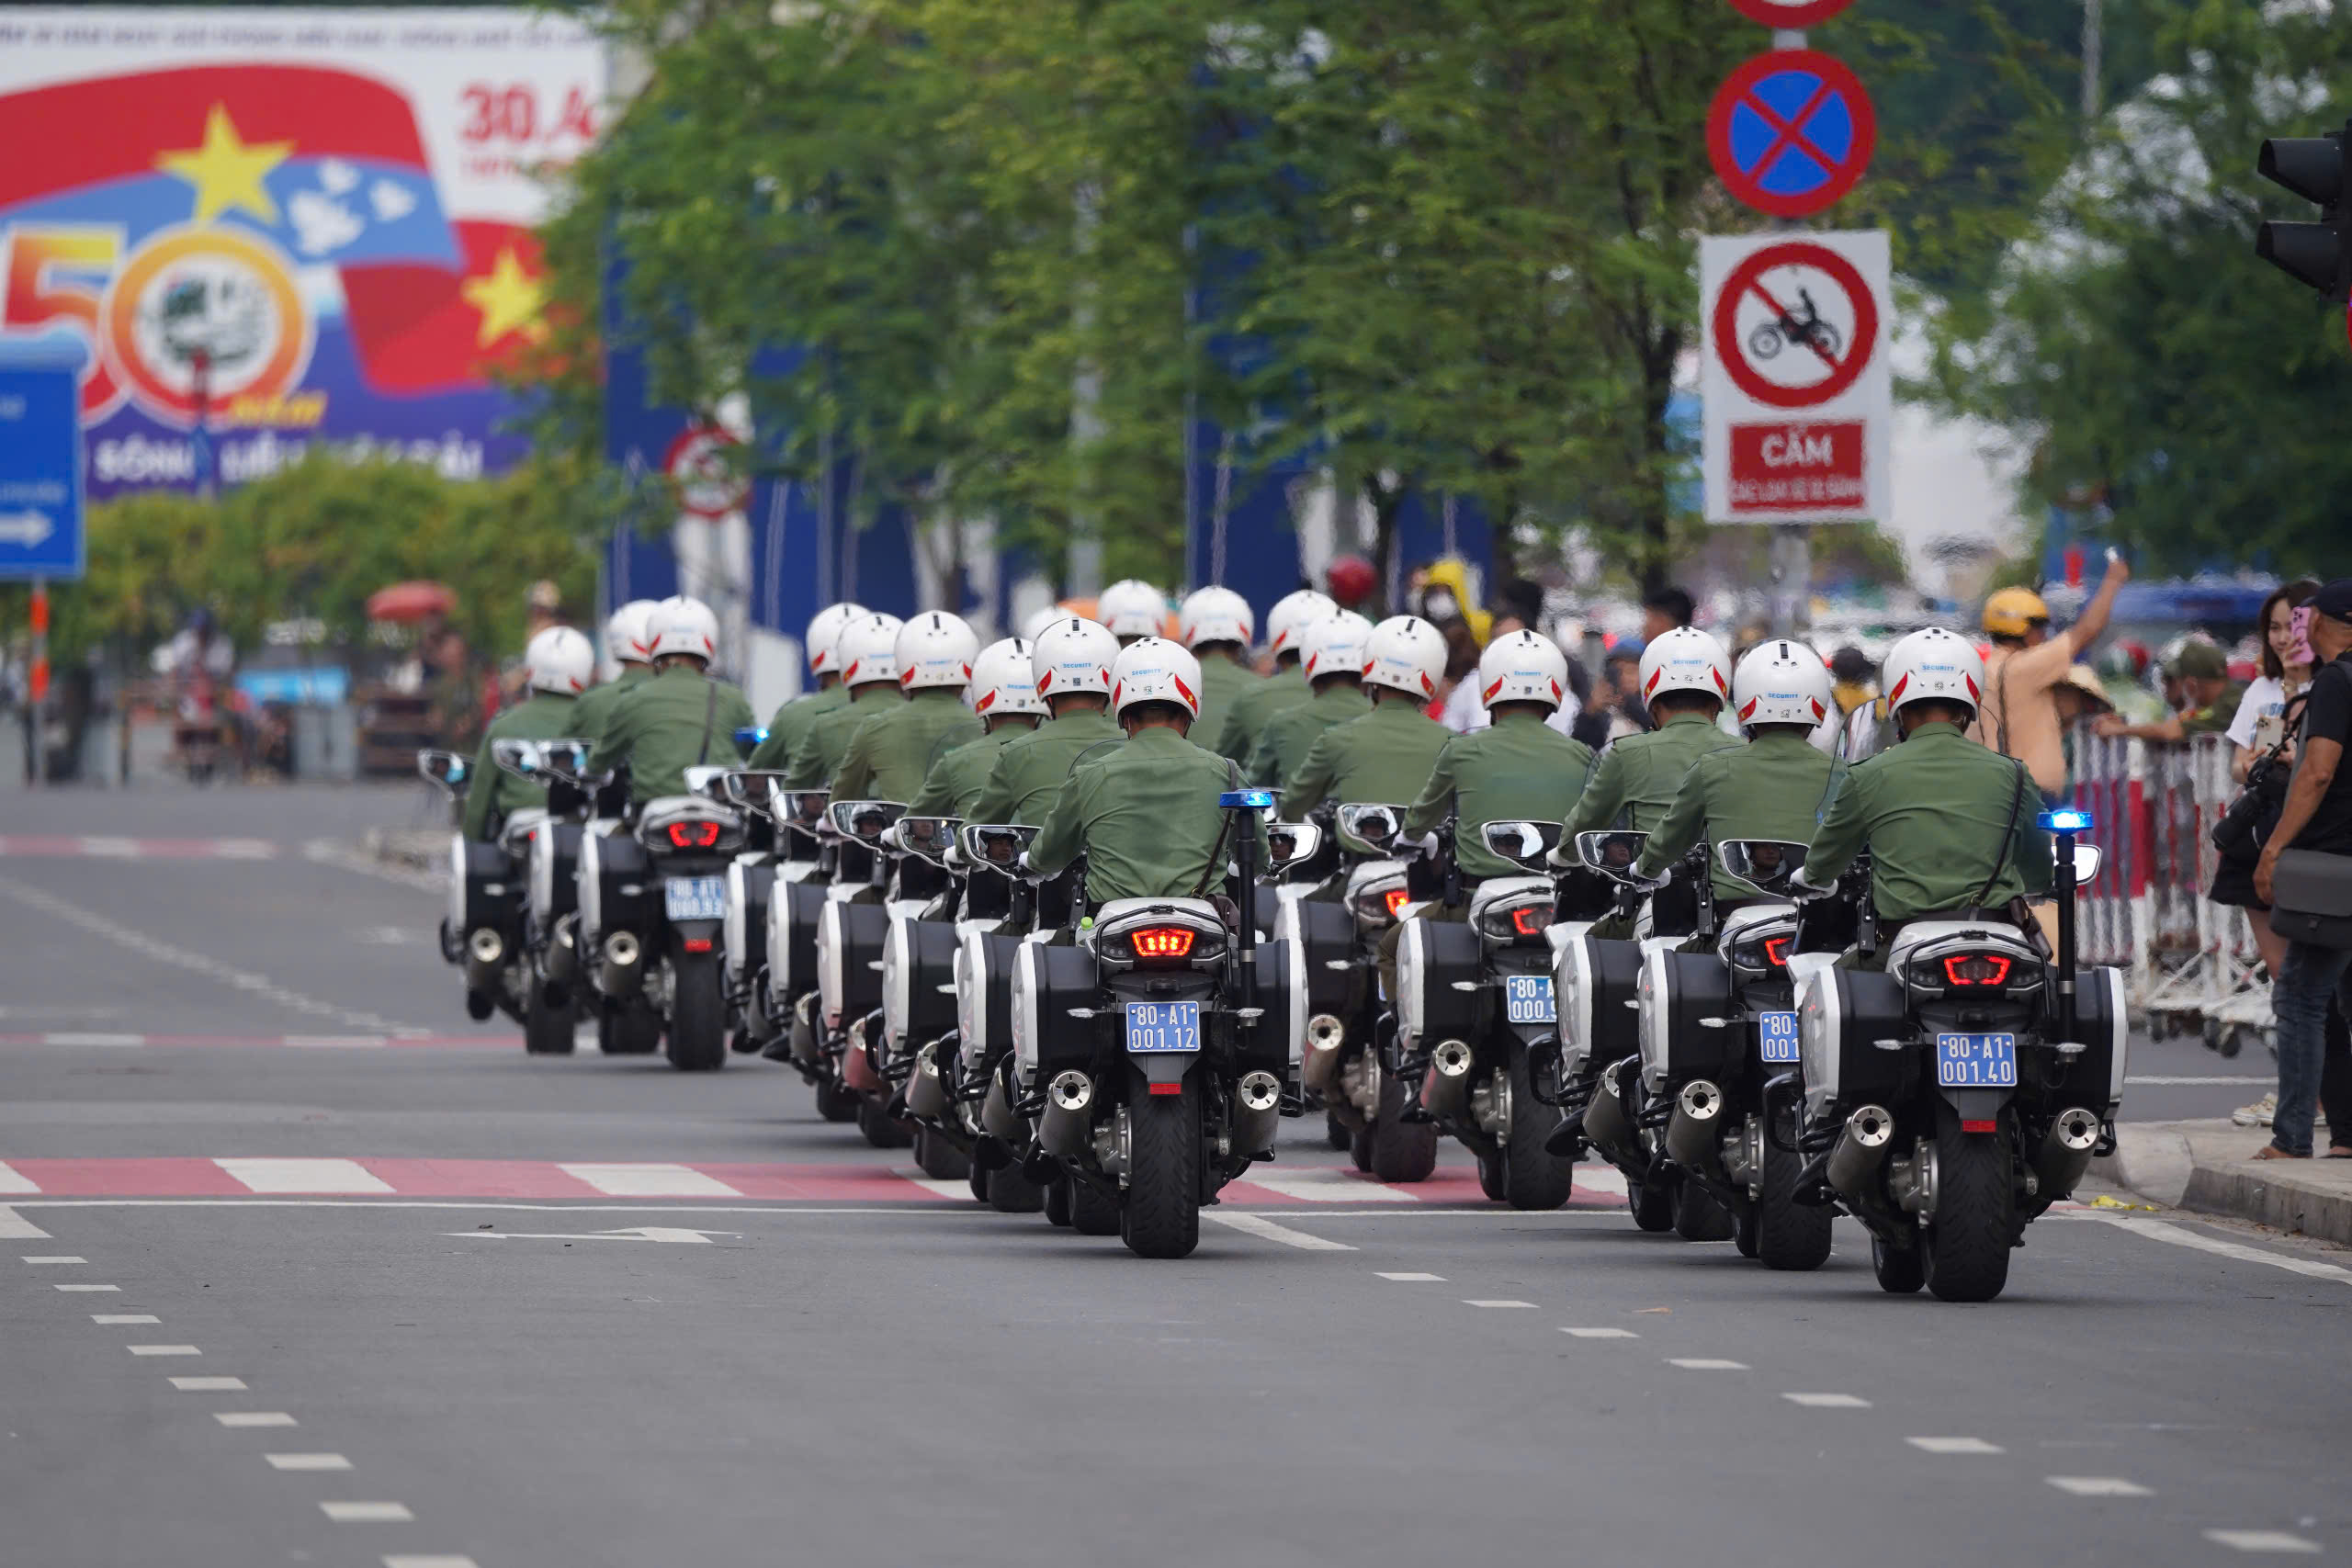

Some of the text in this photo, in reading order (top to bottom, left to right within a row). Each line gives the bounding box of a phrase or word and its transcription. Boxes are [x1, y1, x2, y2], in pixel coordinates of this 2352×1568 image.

[1132, 668, 1161, 676] SECURITY
[1136, 1005, 1188, 1026] 80-A1
[1132, 1027, 1194, 1049] 001.12
[1949, 1037, 2003, 1058] 80-A1
[1943, 1061, 2012, 1083] 001.40
